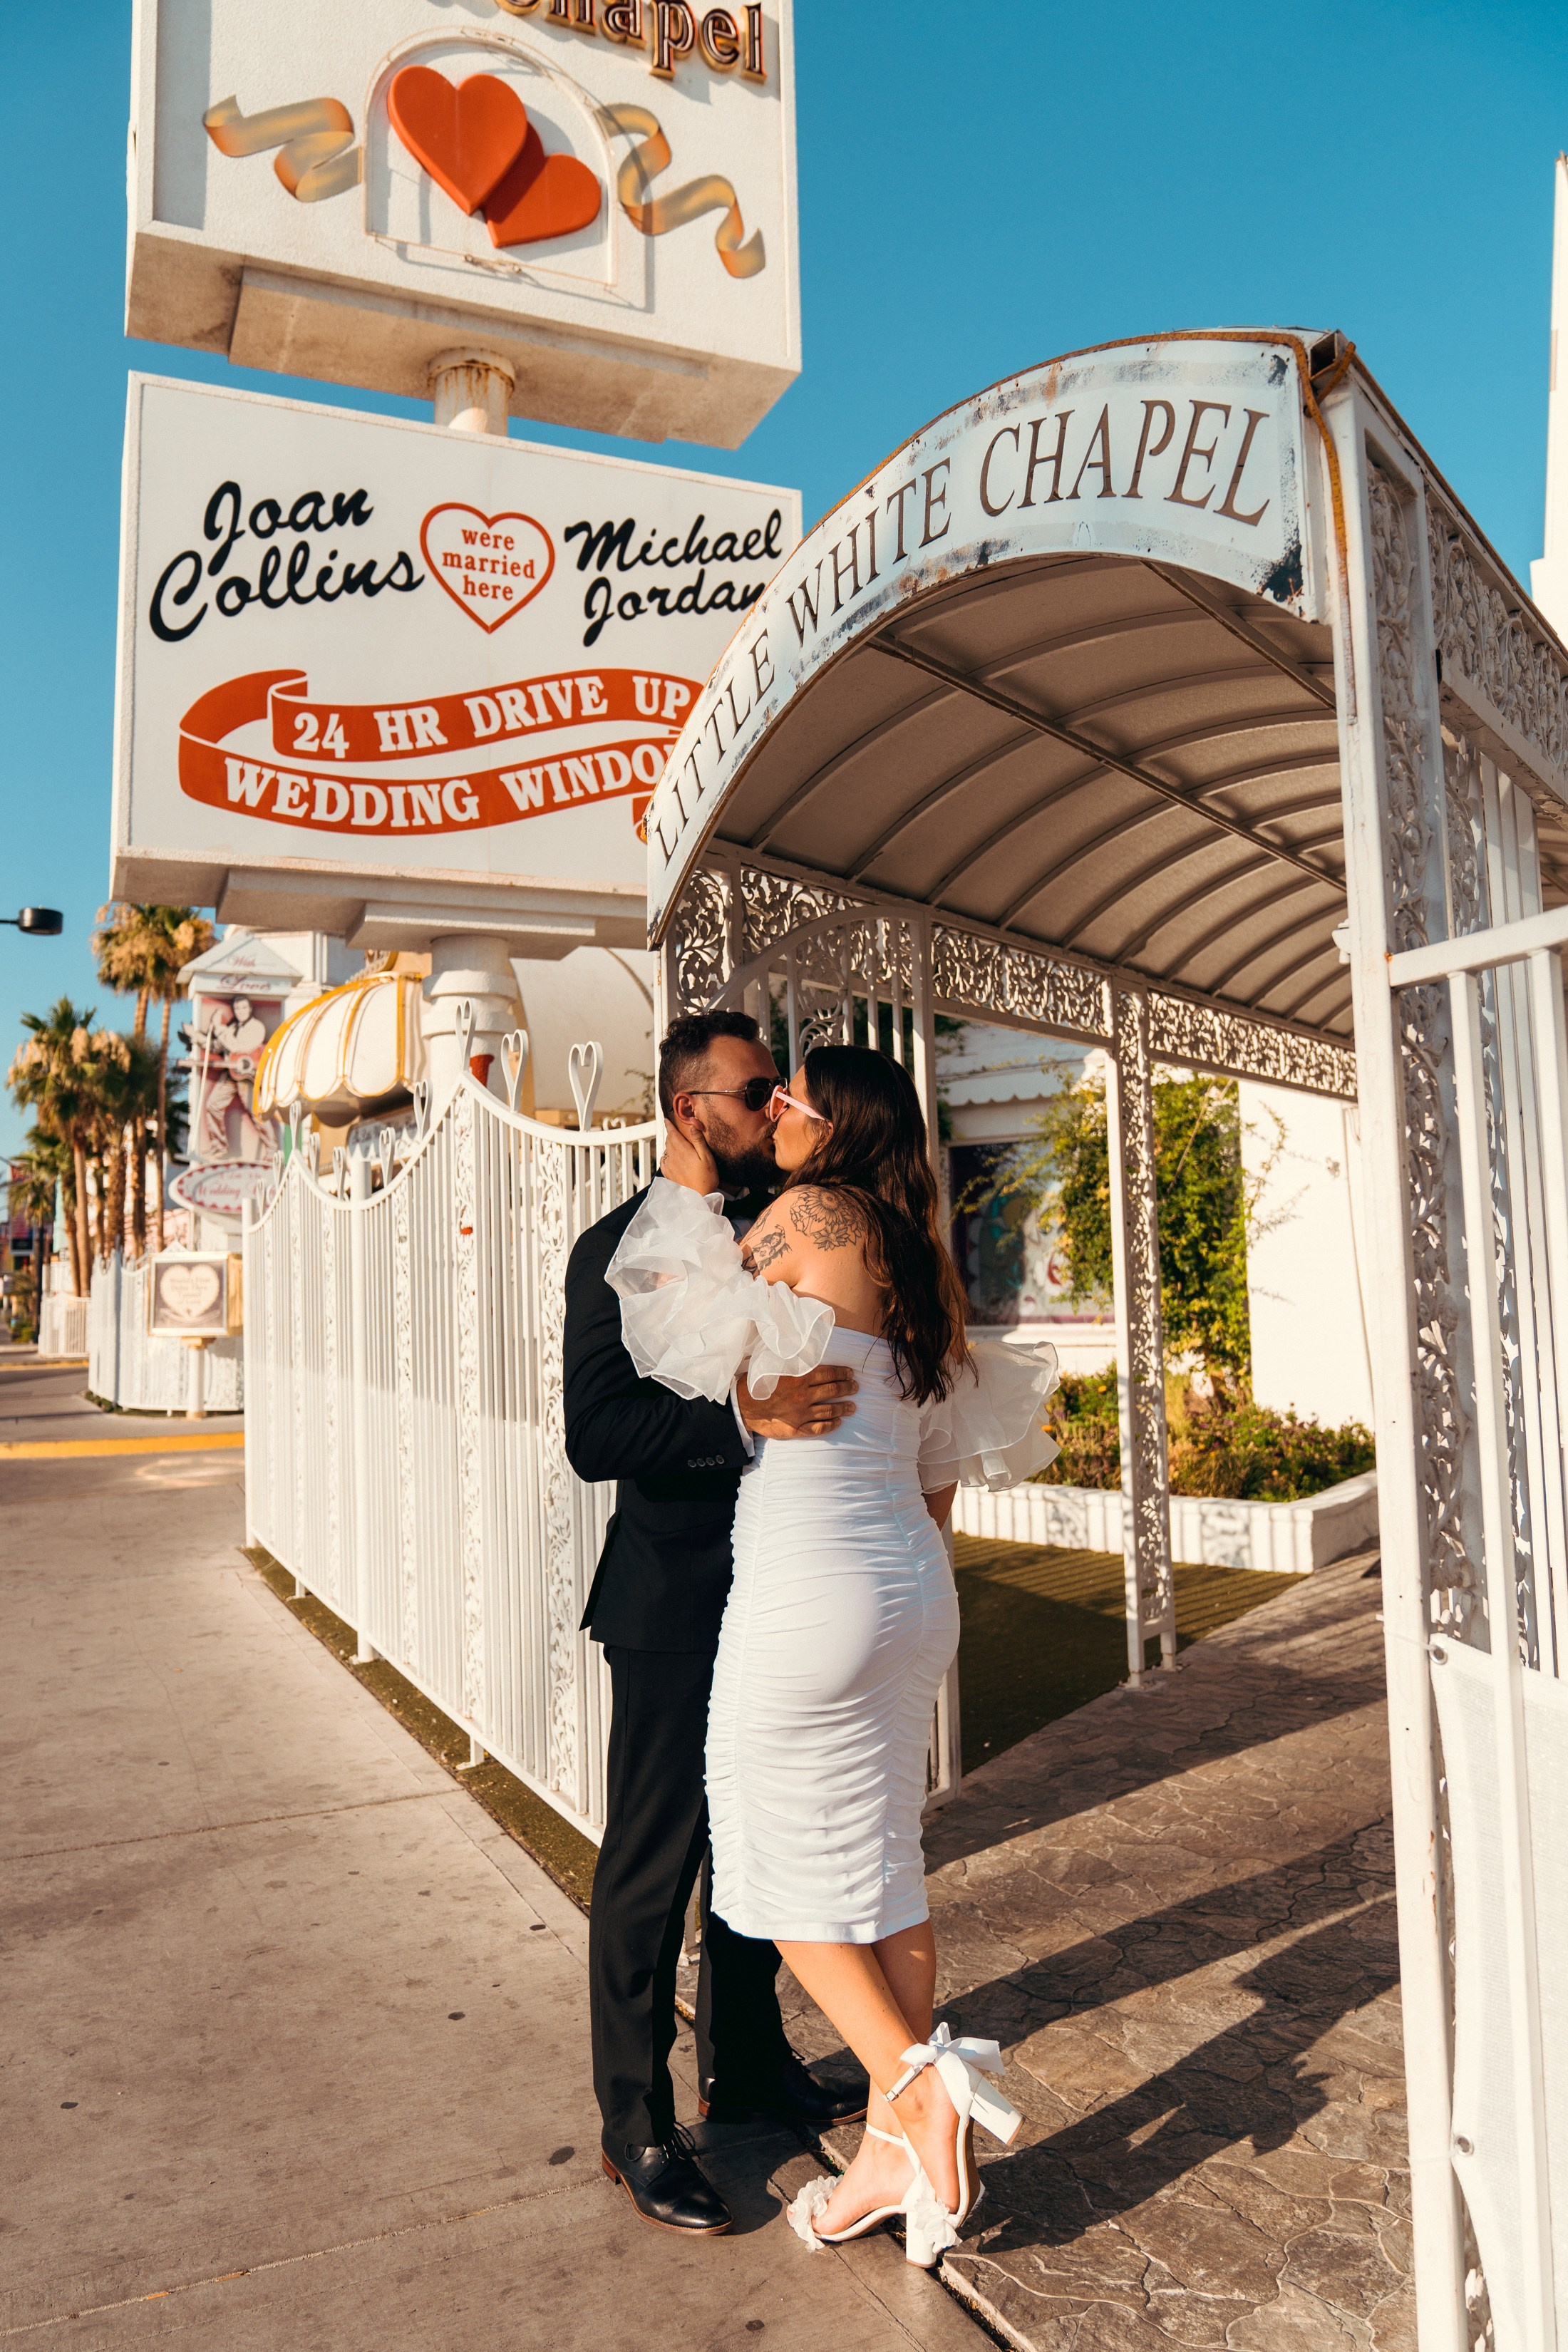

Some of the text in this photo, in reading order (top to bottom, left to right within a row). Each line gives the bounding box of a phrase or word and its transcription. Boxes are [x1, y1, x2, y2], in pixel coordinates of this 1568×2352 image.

[495, 0, 767, 83] apel
[204, 480, 374, 576] Joan
[442, 552, 535, 579] married
[462, 529, 515, 550] were
[564, 508, 783, 572] Michael
[150, 540, 425, 642] Collins
[463, 574, 513, 601] here
[583, 568, 765, 647] Jordan
[654, 399, 1270, 871] LITTLE WHITE CHAPEL
[292, 675, 691, 759] 24 HR DRIVE UP
[225, 743, 675, 827] WEDDING WINDO
